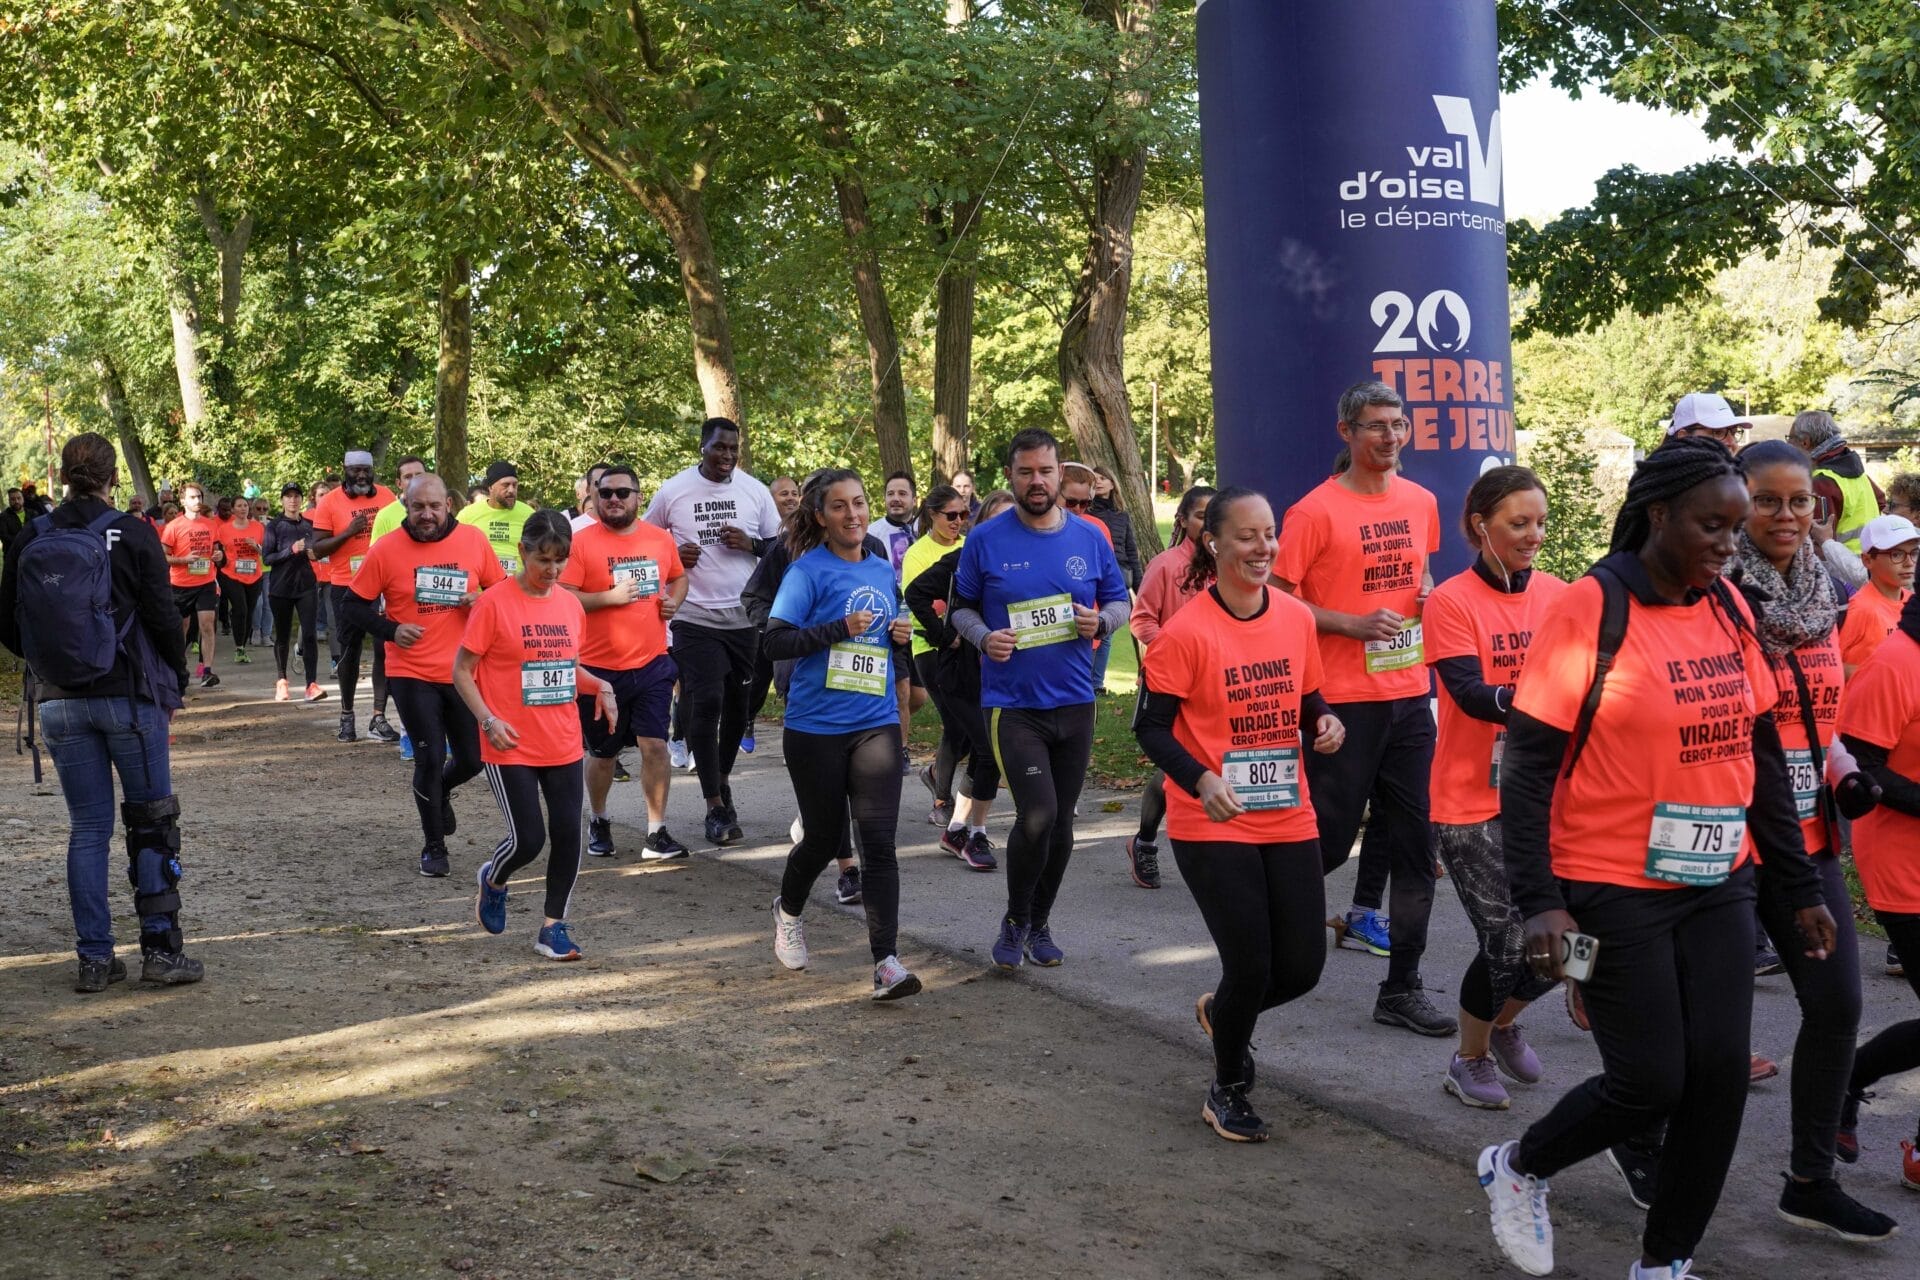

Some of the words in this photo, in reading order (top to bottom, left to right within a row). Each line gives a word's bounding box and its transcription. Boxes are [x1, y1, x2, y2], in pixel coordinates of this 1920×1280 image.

[1406, 141, 1463, 169] val
[1339, 170, 1465, 201] d'oise
[1340, 208, 1366, 229] le
[1373, 358, 1504, 404] TERRE
[694, 503, 703, 514] JE
[705, 500, 737, 512] DONNE
[695, 514, 710, 522] MON
[711, 511, 738, 520] SOUFFLE
[1360, 525, 1372, 541] JE
[1374, 519, 1411, 539] DONNE
[1362, 541, 1382, 555] MON
[1383, 537, 1413, 551] SOUFFLE
[1377, 554, 1393, 563] POUR
[1394, 553, 1402, 562] LA
[629, 568, 647, 581] 769
[1364, 565, 1399, 581] VIRADE
[1401, 562, 1413, 576] DE
[433, 575, 453, 591] 944
[1031, 607, 1057, 627] 558
[522, 625, 533, 637] JE
[534, 624, 569, 637] DONNE
[524, 640, 542, 649] MON
[543, 639, 572, 648] SOUFFLE
[1492, 634, 1505, 651] JE
[537, 650, 553, 658] POUR
[1493, 655, 1517, 668] MON
[1800, 653, 1838, 668] OUFFLE
[852, 654, 874, 674] 616
[1224, 667, 1240, 687] JE
[1242, 658, 1292, 683] DONNE
[1667, 661, 1688, 684] JE
[1687, 651, 1745, 681] DONNE
[543, 670, 563, 687] 847
[1227, 687, 1251, 703] MON
[1254, 680, 1295, 699] SOUFFLE
[1674, 686, 1706, 705] MON
[1822, 686, 1840, 705] DE
[1247, 702, 1269, 713] POUR
[1270, 699, 1281, 710] LA
[1701, 703, 1729, 720] POUR
[1732, 701, 1743, 715] LA
[1229, 715, 1279, 734] VIRADE
[1281, 709, 1297, 727] DE
[1679, 718, 1739, 748] VIRADE
[1249, 761, 1277, 785] 802
[1691, 823, 1723, 852] 779
[1680, 864, 1704, 872] COURSE
